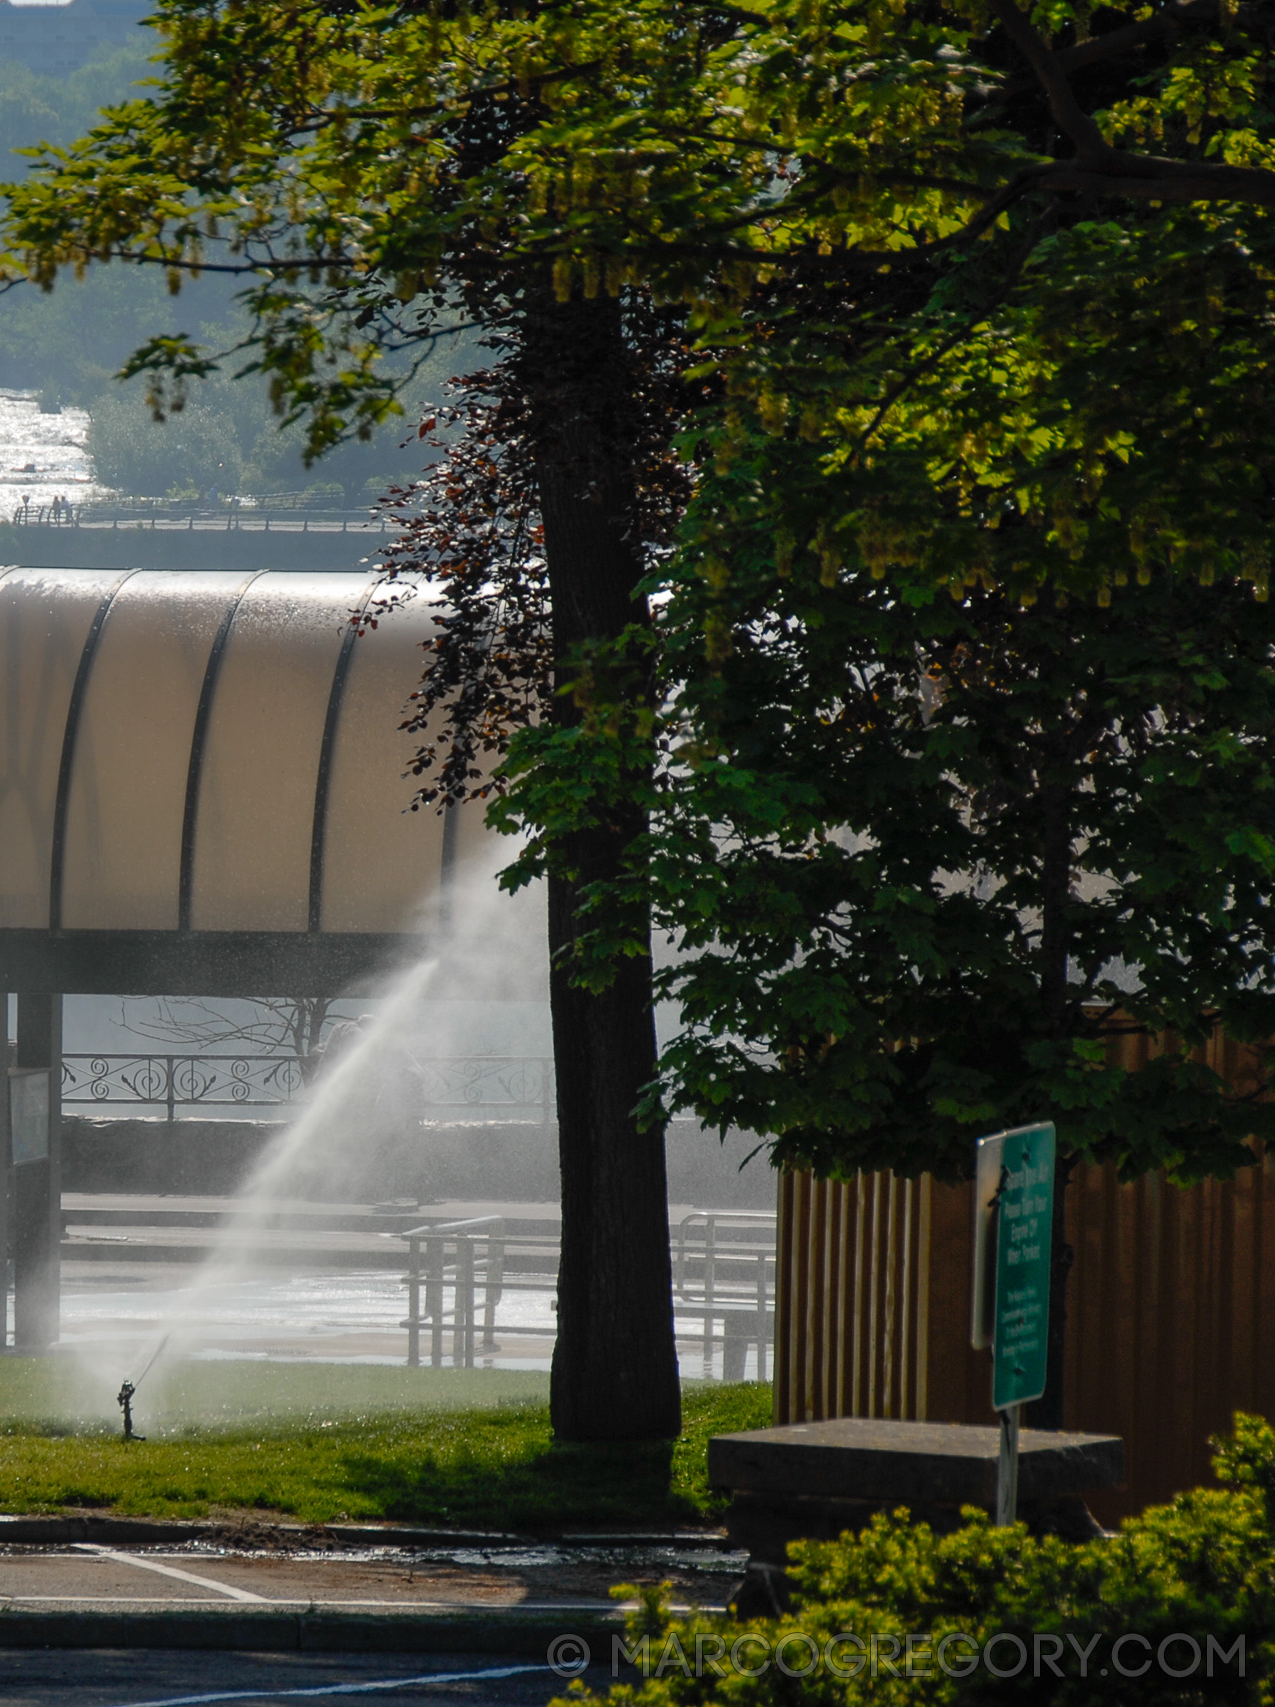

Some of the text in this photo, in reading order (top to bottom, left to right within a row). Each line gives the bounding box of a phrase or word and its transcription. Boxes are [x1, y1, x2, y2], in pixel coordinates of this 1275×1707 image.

[1005, 1195, 1047, 1218] Please Turn Your
[1011, 1223, 1028, 1245] Engine
